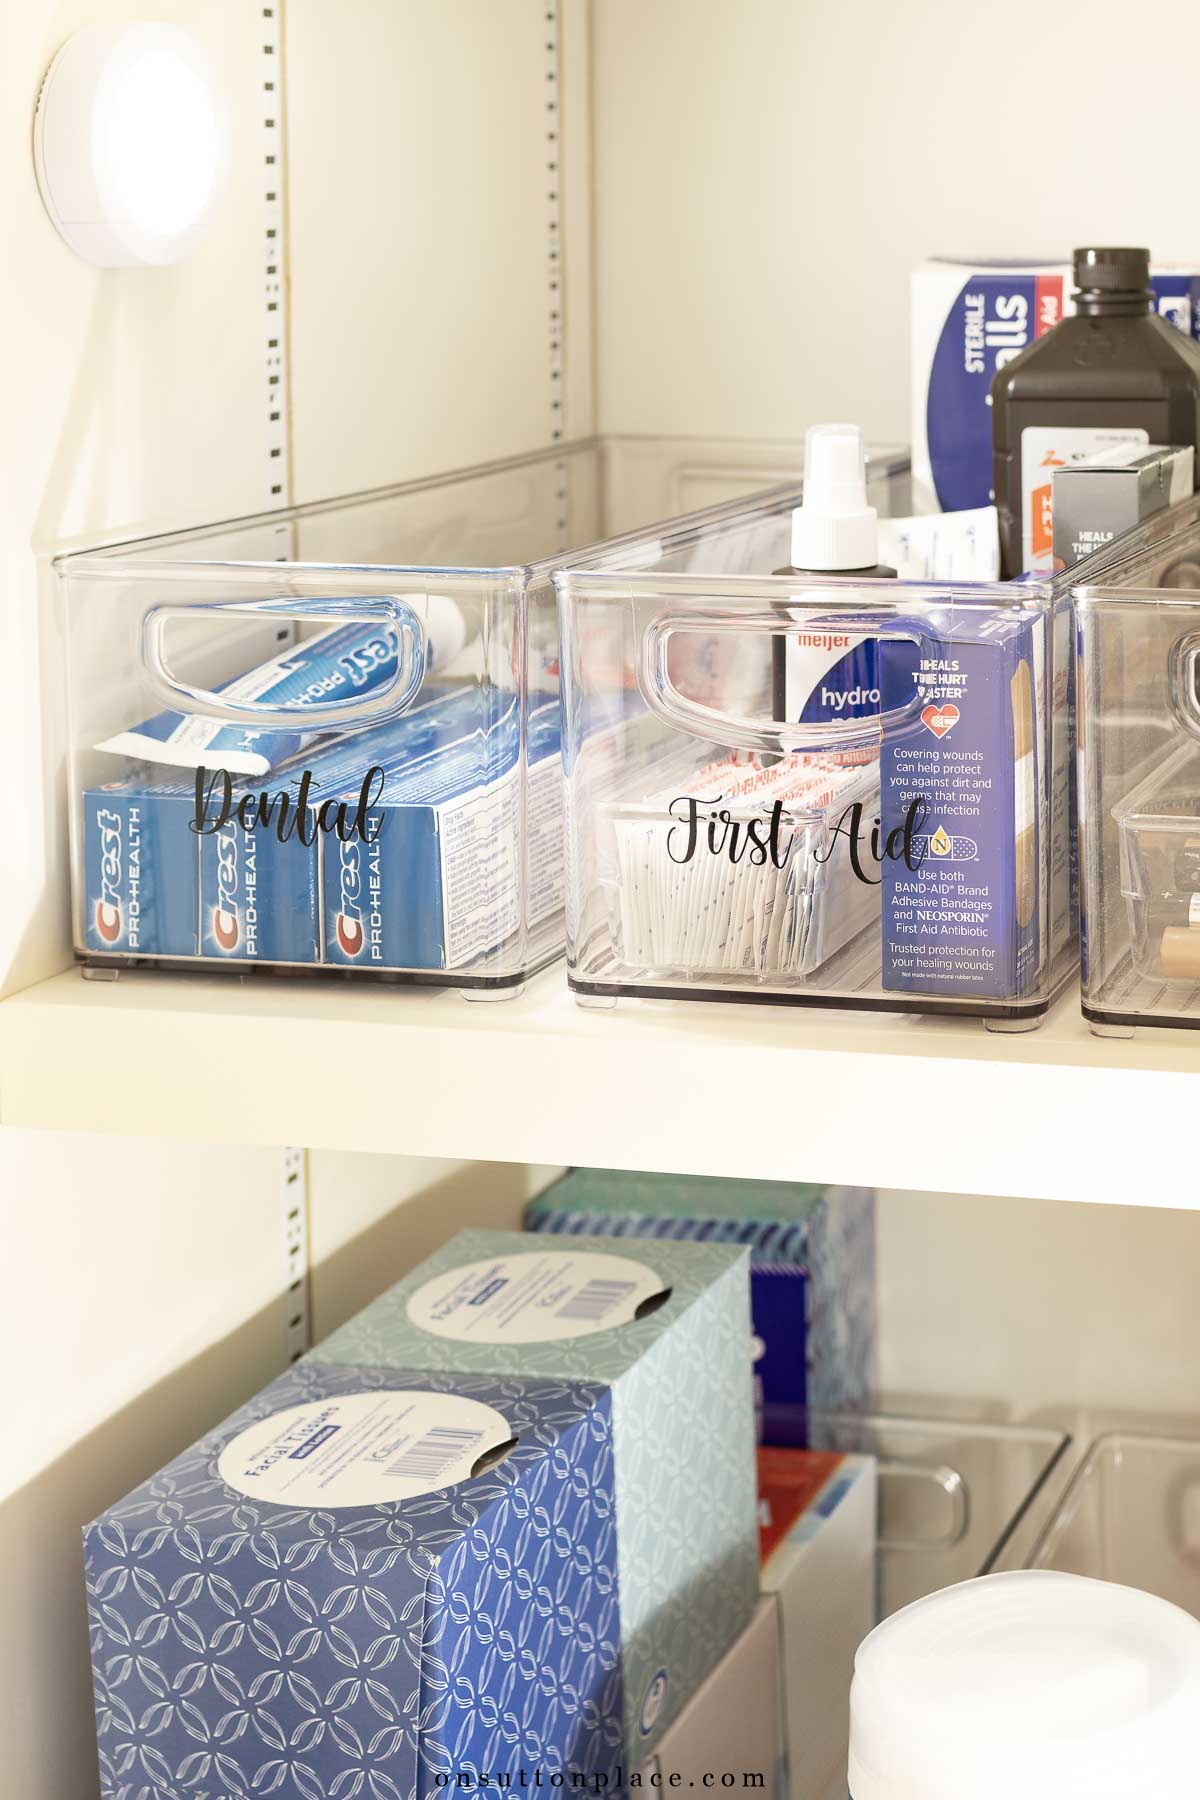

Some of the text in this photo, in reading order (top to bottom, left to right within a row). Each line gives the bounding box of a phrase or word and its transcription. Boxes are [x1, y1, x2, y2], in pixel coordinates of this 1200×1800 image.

[965, 293, 985, 374] STERILE
[1079, 531, 1113, 543] HEALS
[338, 628, 398, 687] rest
[938, 673, 968, 685] HURT
[893, 748, 940, 761] Covering
[942, 750, 984, 761] wounds
[896, 762, 981, 775] can help protect
[890, 776, 992, 789] you against dirt and
[900, 790, 981, 804] germs that may
[188, 766, 385, 847] Dental
[934, 804, 980, 816] infection
[666, 795, 930, 885] First Aid
[95, 808, 123, 942] Crest
[917, 870, 965, 881] Use both
[957, 885, 989, 896] Brand
[891, 895, 993, 911] Adhesive Bandages
[893, 910, 913, 920] and
[896, 923, 989, 937] First Aid Antibiotic
[889, 942, 996, 958] Trusted protection for
[891, 957, 994, 971] your healing wounds
[243, 1446, 294, 1477] Facial
